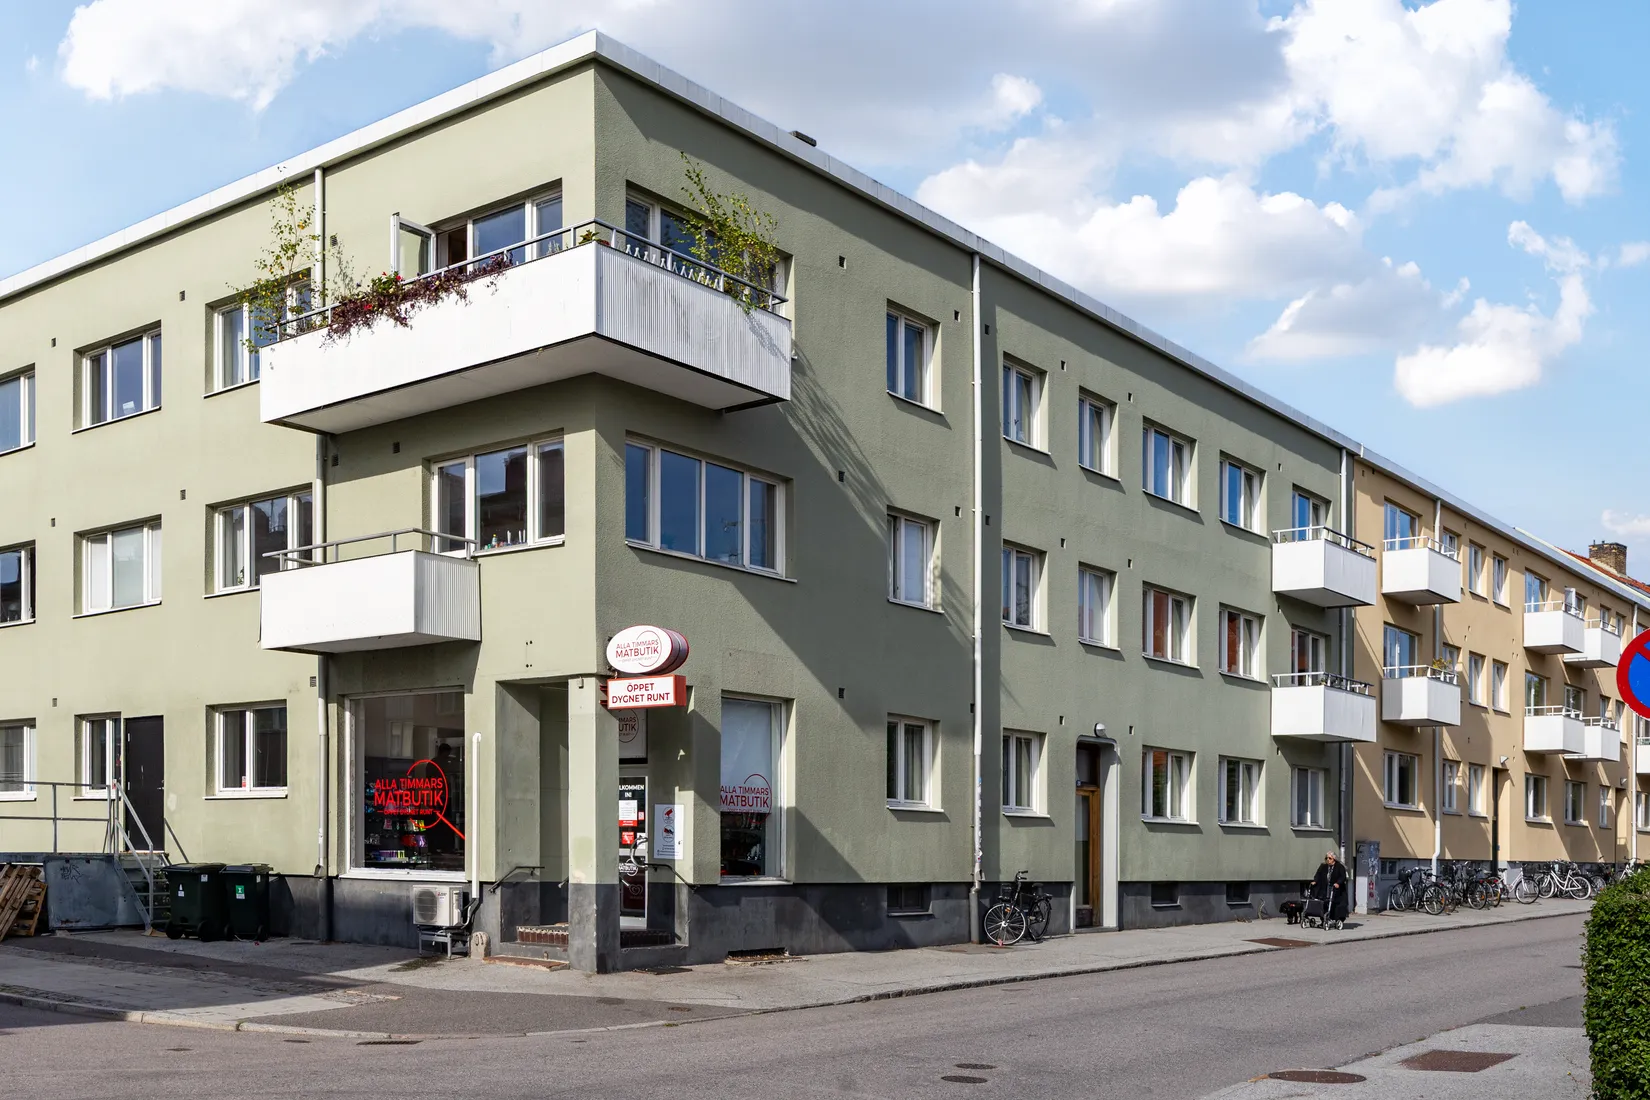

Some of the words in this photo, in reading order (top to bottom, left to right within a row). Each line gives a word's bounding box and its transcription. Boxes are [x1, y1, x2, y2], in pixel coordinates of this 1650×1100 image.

[632, 639, 659, 648] TIMMARS
[616, 646, 659, 658] MATBUTIK
[626, 682, 654, 692] ÖPPET
[612, 694, 644, 704] DYGNET
[646, 692, 670, 702] RUNT
[619, 722, 636, 732] UTIK
[375, 778, 398, 790] ALLA
[400, 778, 444, 789] TIMMARS
[720, 786, 736, 794] ALLA
[738, 786, 769, 796] TIMMARS
[374, 790, 444, 807] MATBUTIK
[720, 794, 770, 808] MATBUTIK
